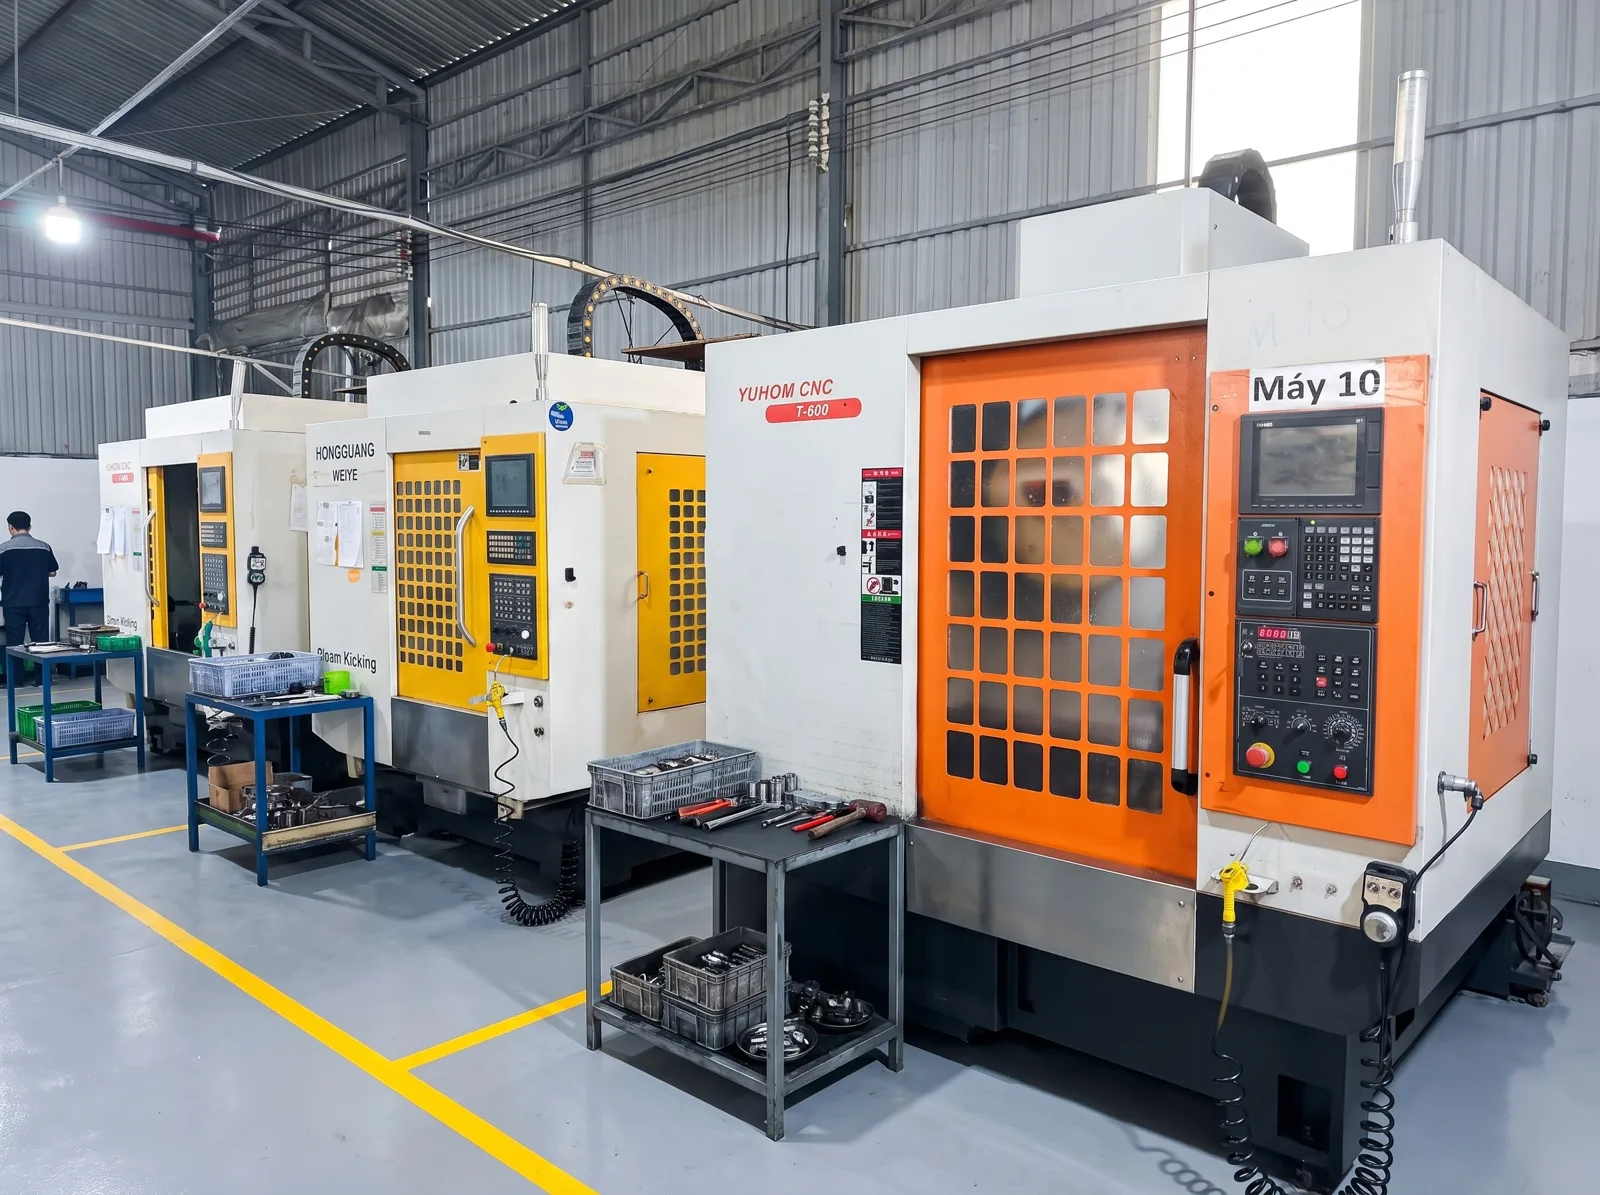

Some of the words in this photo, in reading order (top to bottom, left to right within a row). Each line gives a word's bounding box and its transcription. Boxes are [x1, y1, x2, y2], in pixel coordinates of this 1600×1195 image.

[738, 382, 795, 402] YUHOM
[800, 378, 834, 397] CNC
[1253, 372, 1326, 405] Máy
[1339, 369, 1380, 397] 10
[796, 403, 829, 418] T-600
[315, 442, 375, 461] HONGGUANG
[332, 468, 358, 482] WEIYE
[343, 650, 377, 674] Kicking
